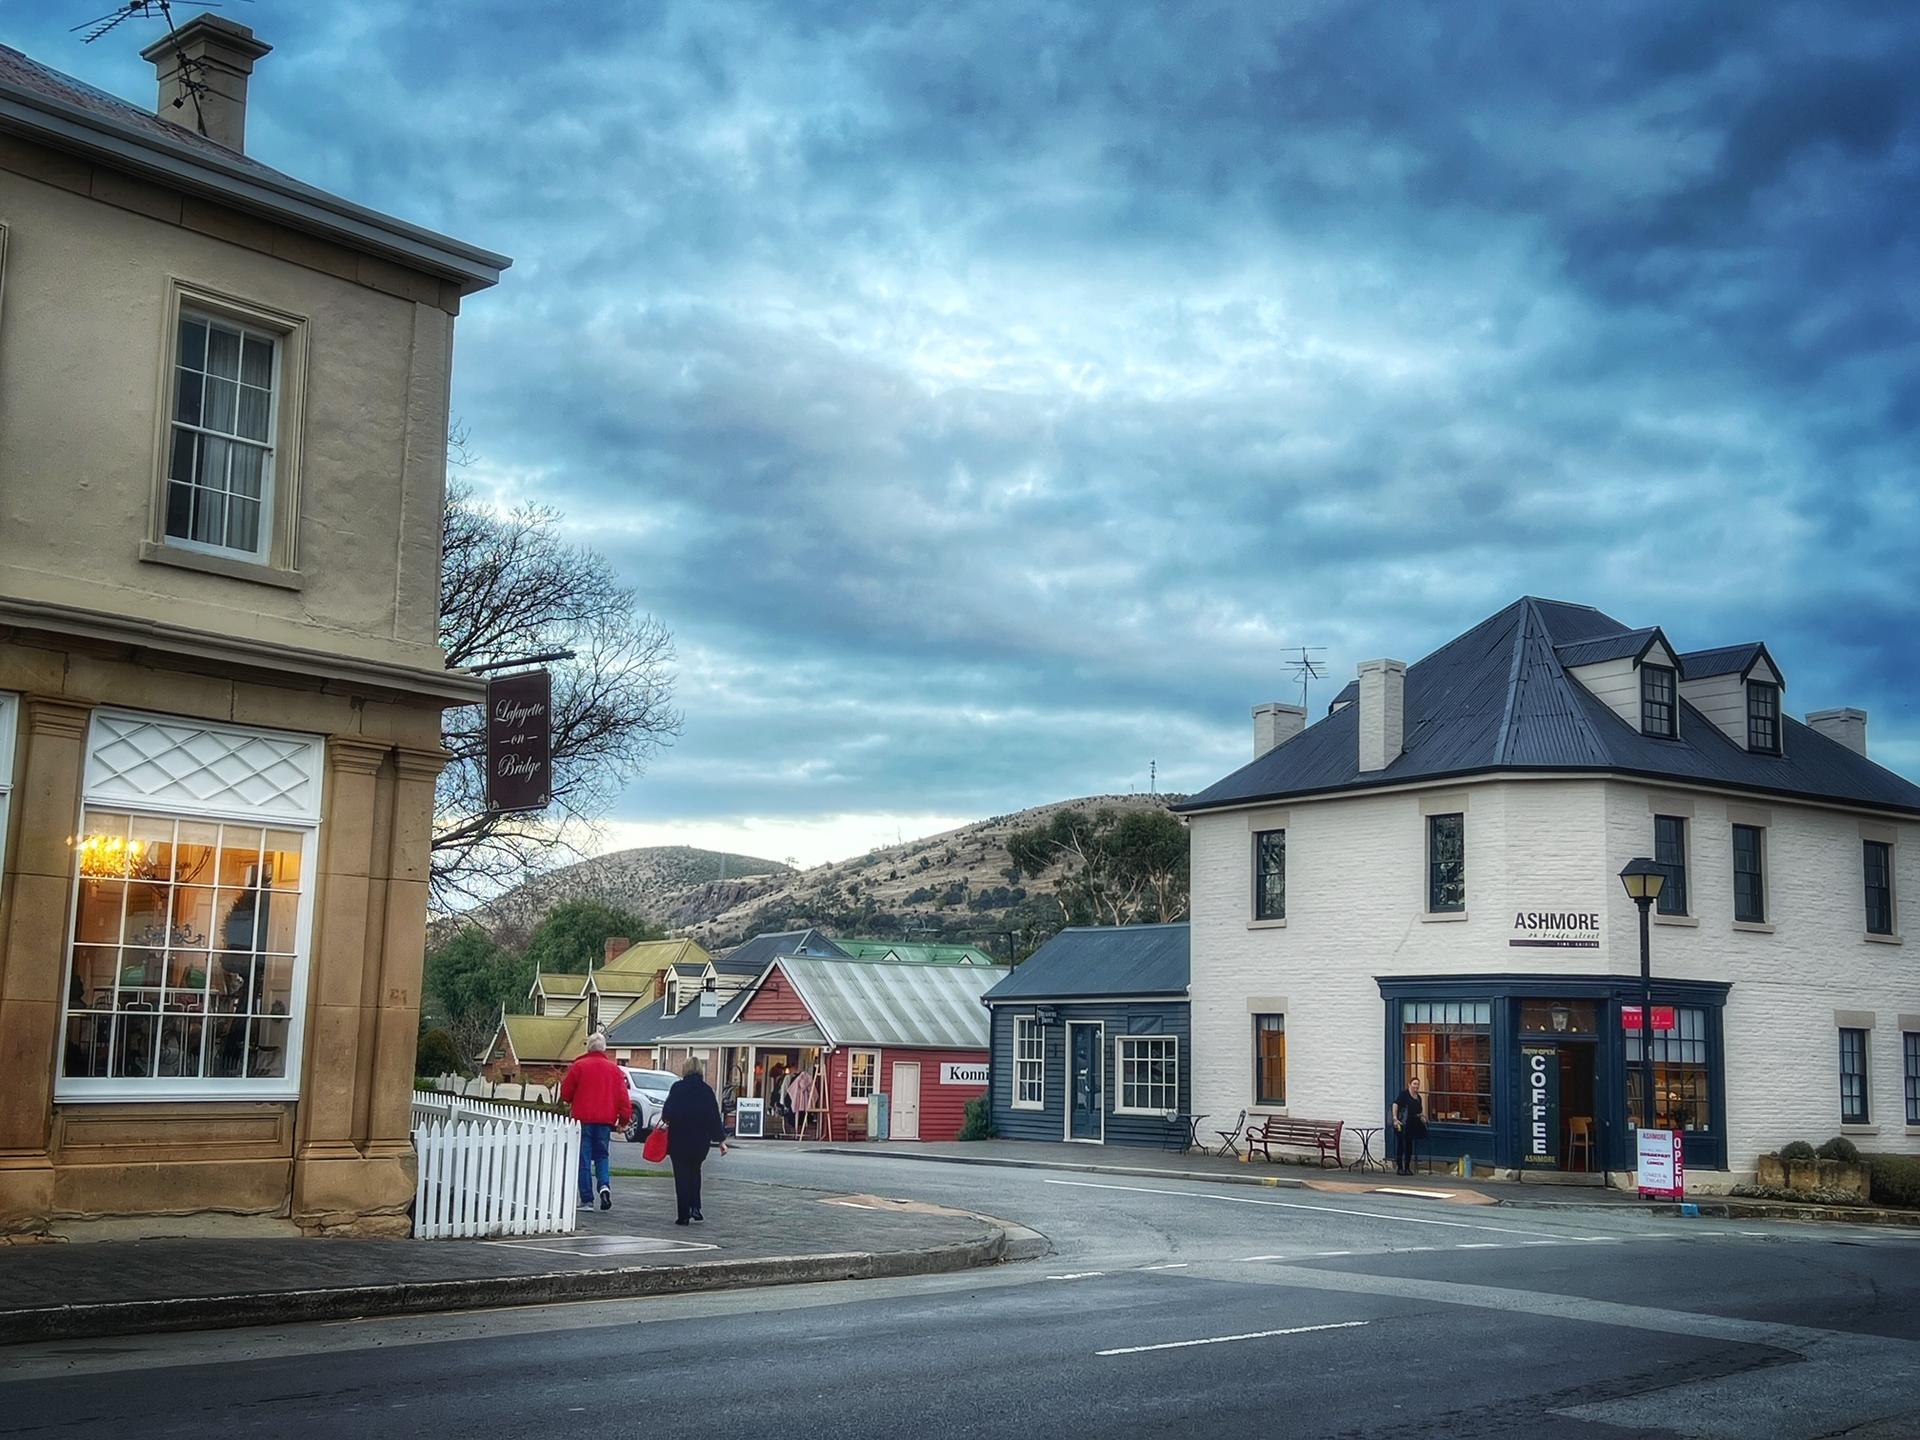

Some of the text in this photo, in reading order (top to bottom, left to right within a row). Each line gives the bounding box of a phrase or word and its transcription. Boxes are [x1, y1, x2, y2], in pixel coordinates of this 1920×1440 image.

[495, 699, 545, 728] Lafayette
[498, 753, 542, 783] Bridge
[1513, 912, 1600, 930] ASHMORE
[1530, 1055, 1547, 1154] COFFEE
[1674, 1137, 1682, 1188] OPEN
